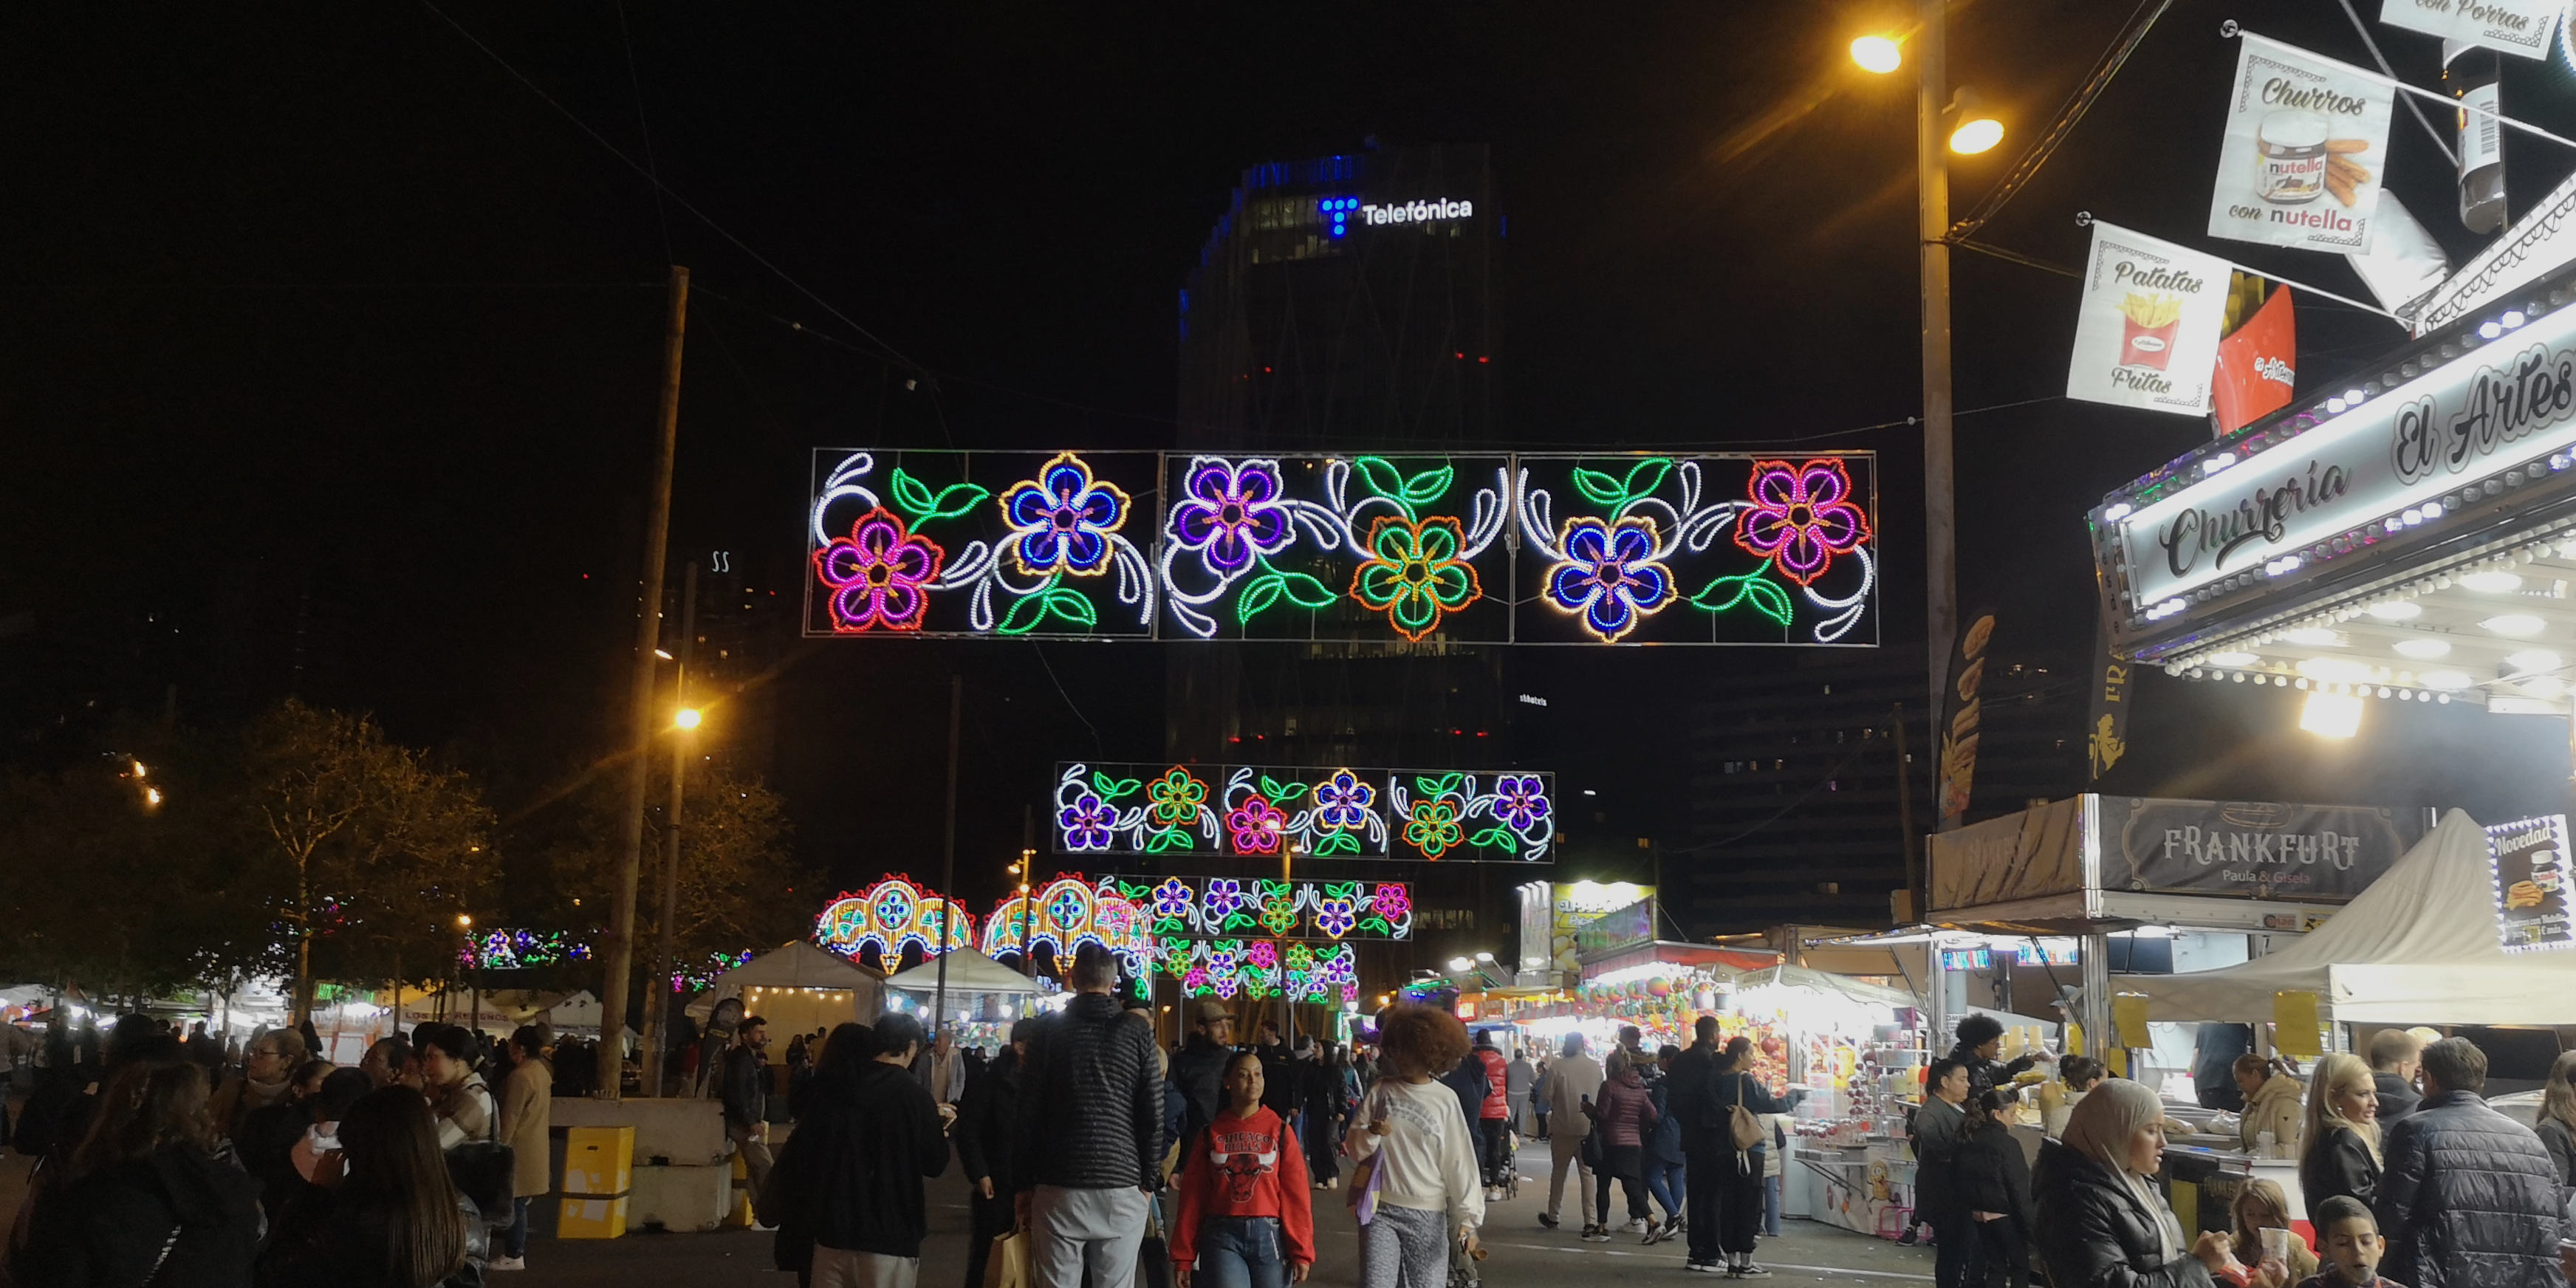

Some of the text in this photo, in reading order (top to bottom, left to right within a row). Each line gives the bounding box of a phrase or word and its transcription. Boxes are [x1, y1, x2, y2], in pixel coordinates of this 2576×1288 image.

[2455, 0, 2529, 31] Porras
[2262, 78, 2366, 116] Churros
[2270, 157, 2323, 174] nutella
[1362, 196, 1473, 226] Telefónica
[2229, 204, 2352, 232] con nutella
[2114, 261, 2204, 294] Patatas
[2111, 367, 2173, 394] Fritas
[2158, 353, 2572, 578] Churrería El Artes
[2164, 825, 2360, 871] FRANKFURT
[2494, 823, 2552, 857] Novedad
[2222, 869, 2311, 885] Paula & Gisela
[1216, 1131, 1271, 1144] CHICAGO
